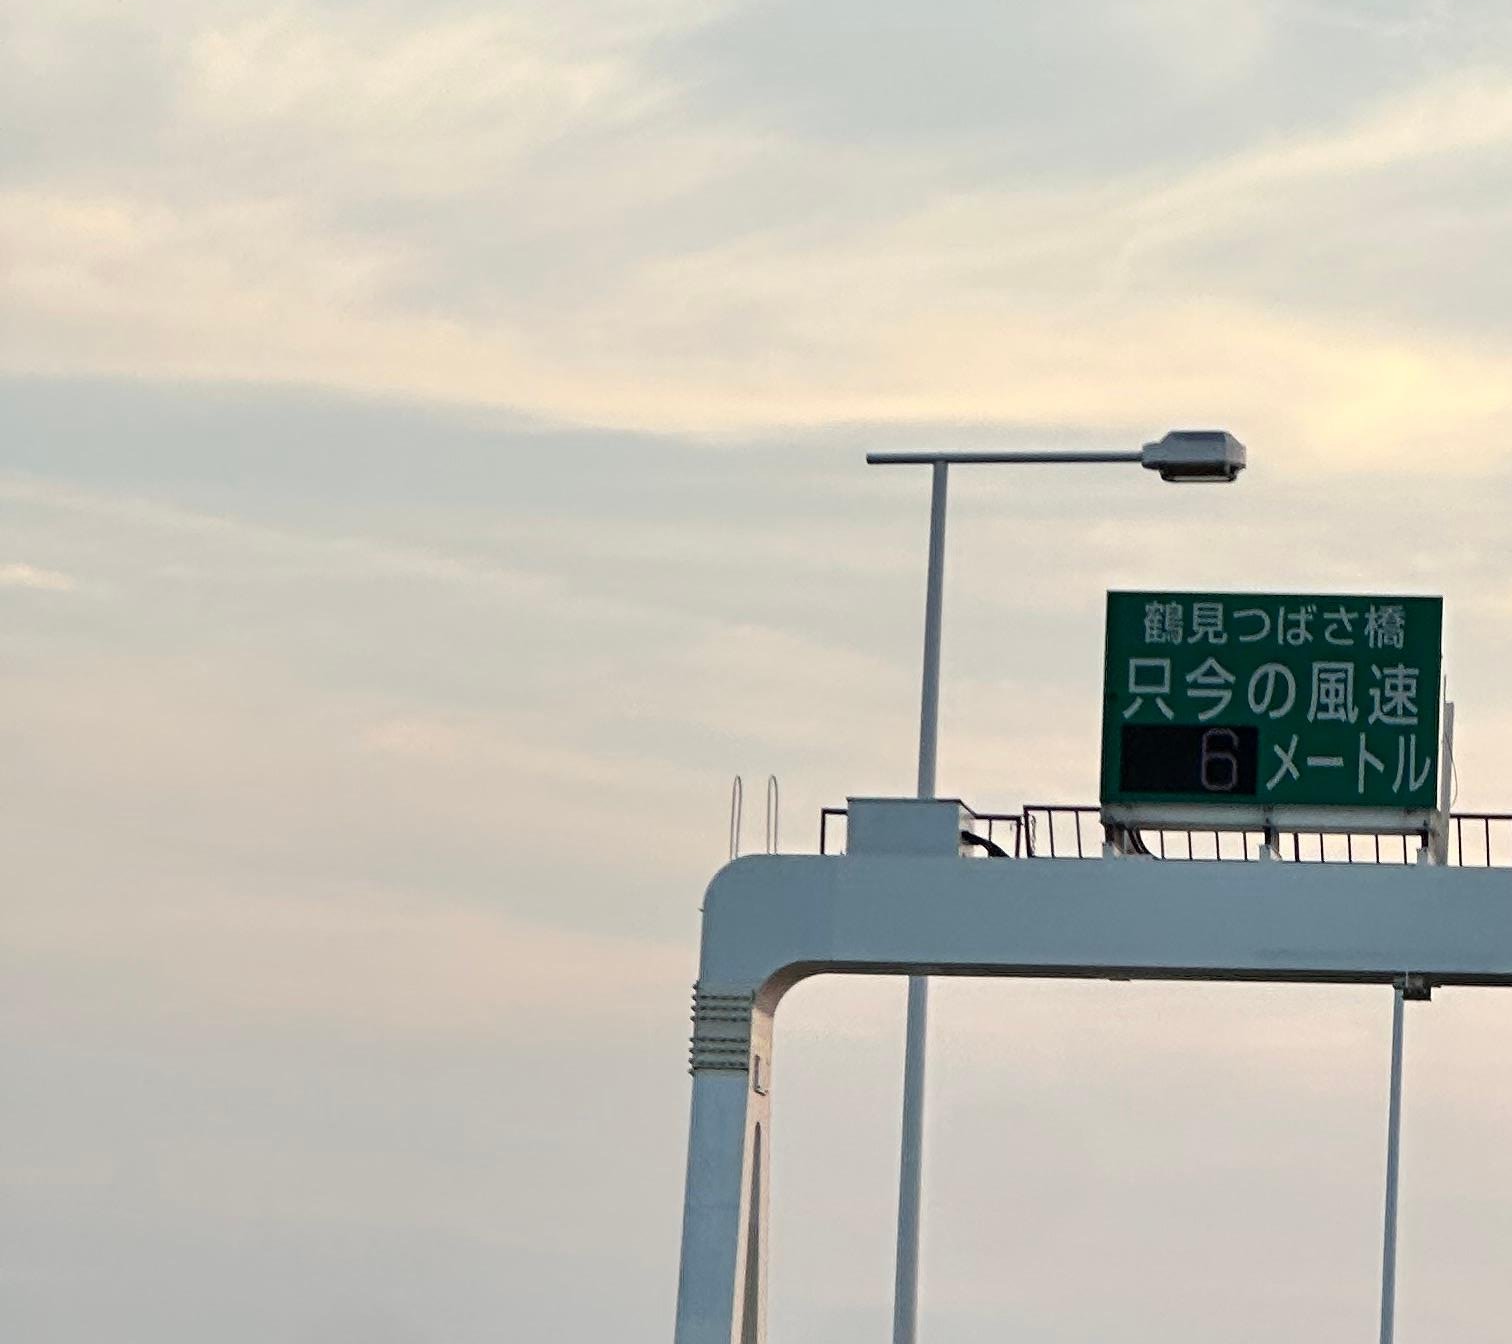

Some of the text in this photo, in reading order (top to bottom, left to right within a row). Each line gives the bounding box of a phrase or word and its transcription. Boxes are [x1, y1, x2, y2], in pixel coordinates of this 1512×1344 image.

[1143, 601, 1406, 649] 鶴見つばさ橋
[1122, 657, 1420, 725] 只今の風速
[1201, 728, 1239, 791] 6
[1265, 733, 1431, 794] メートル
